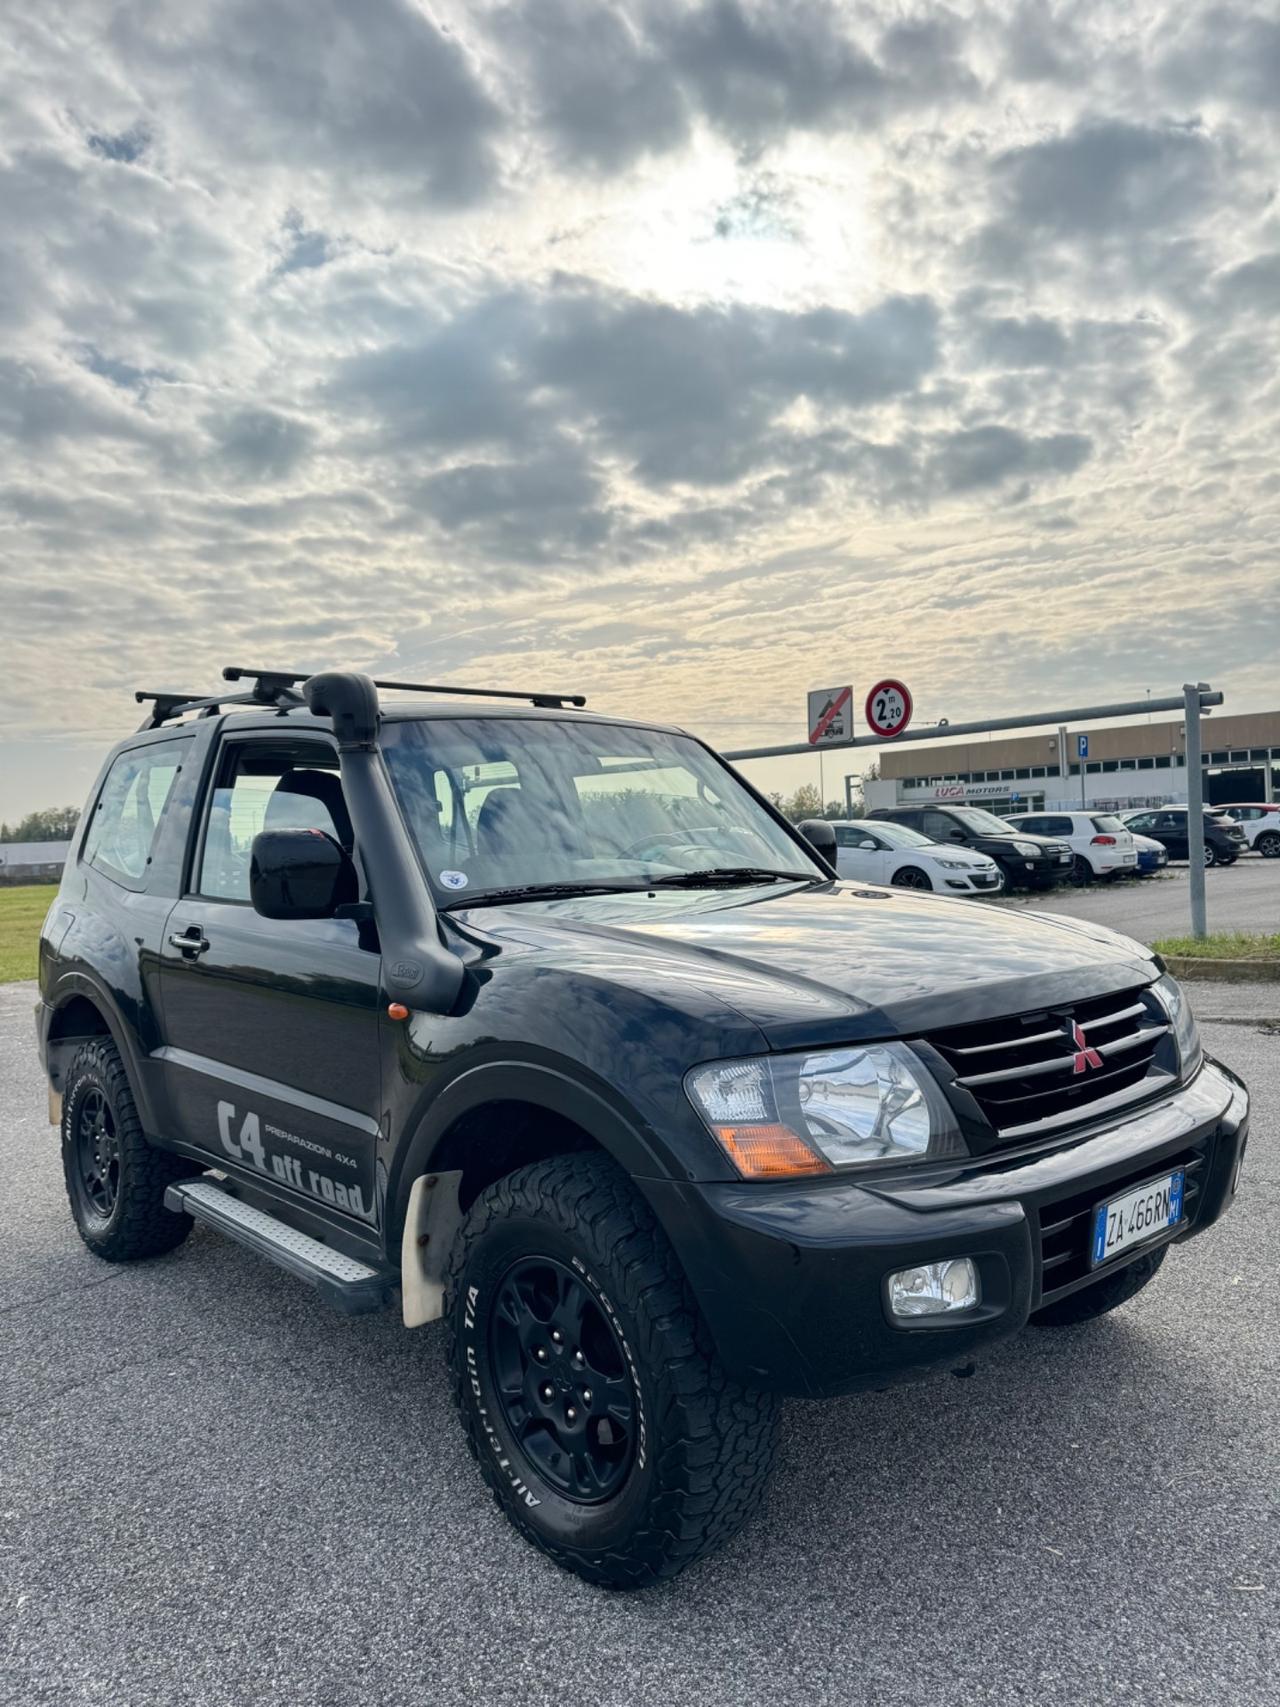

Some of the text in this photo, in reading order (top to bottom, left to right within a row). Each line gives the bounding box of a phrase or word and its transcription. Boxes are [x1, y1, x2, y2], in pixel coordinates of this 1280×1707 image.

[1080, 737, 1087, 754] P
[966, 786, 1010, 795] MOTORS
[271, 1154, 369, 1217] off road
[463, 1285, 480, 1330] T/A
